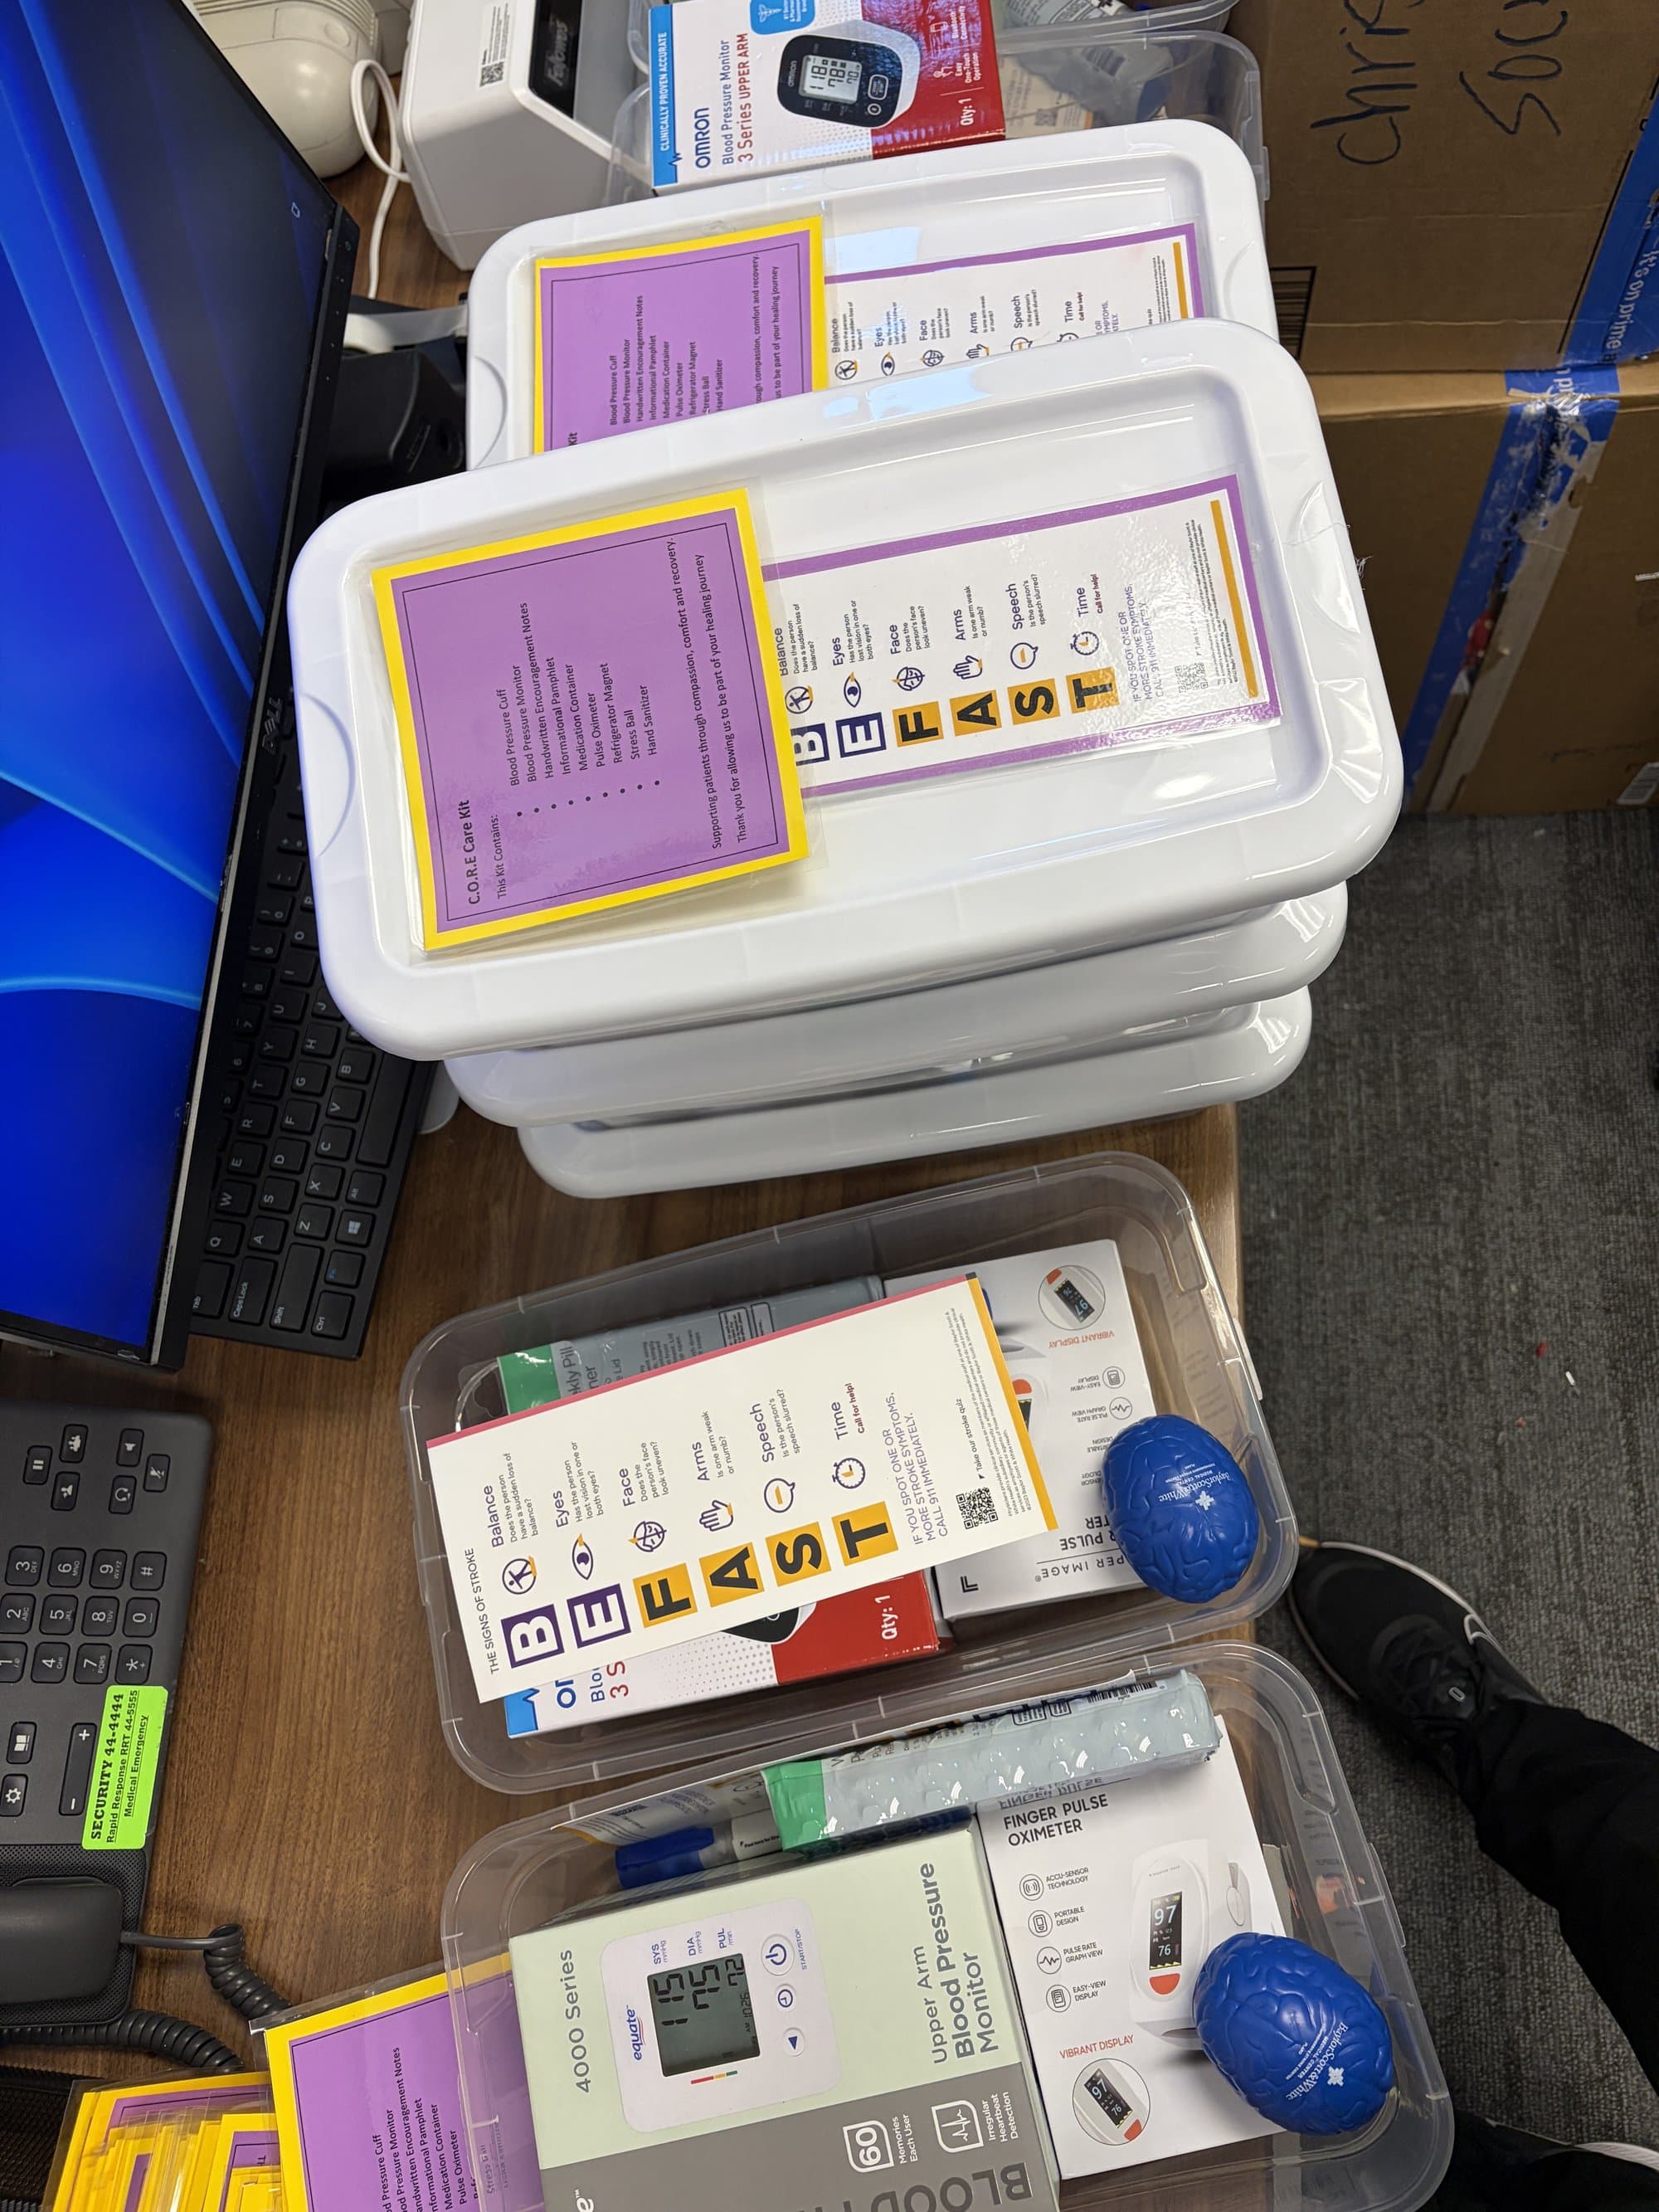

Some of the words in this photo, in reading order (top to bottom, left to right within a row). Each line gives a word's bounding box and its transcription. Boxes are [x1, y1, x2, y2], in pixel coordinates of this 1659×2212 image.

[658, 32, 668, 72] ACCURATE
[718, 40, 731, 81] Monitor
[736, 32, 749, 58] ARM
[659, 73, 669, 105] PROVEN
[737, 61, 751, 100] UPPER
[721, 84, 732, 131] Pressure
[736, 102, 753, 149] Series
[960, 105, 976, 126] Qty:
[659, 105, 669, 152] CLINICALLY
[721, 133, 734, 165] Blood
[737, 153, 754, 163] 3
[635, 295, 644, 318] Notes
[635, 318, 645, 376] Encouragement
[635, 376, 645, 422] Handwritten
[666, 538, 681, 585] recovery.
[694, 554, 711, 593] journey
[672, 587, 685, 607] and
[702, 594, 715, 632] healing
[1005, 583, 1025, 631] Speech
[1076, 587, 1089, 618] Time
[520, 602, 532, 634] Notes
[677, 608, 692, 649] comfort
[953, 609, 966, 641] Arms
[708, 633, 722, 656] your
[832, 637, 845, 666] Eyes
[889, 624, 902, 655] Face
[523, 635, 545, 714] Encouragement
[545, 656, 562, 705] Pamphlet
[686, 650, 703, 712] compassion,
[709, 658, 722, 669] of
[713, 670, 727, 691] part
[495, 689, 509, 710] Cuff
[512, 665, 526, 706] Monitor
[565, 664, 580, 713] Container
[599, 662, 614, 702] Magnet
[717, 693, 727, 707] be
[1072, 678, 1113, 709] T
[587, 692, 601, 738] Oximeter
[623, 709, 635, 728] Ball
[639, 685, 654, 728] Sanitizer
[721, 708, 729, 719] to
[956, 692, 997, 726] A
[1014, 686, 1054, 717] S
[503, 711, 516, 755] Pressure
[519, 708, 533, 752] Pressure
[552, 706, 572, 775] Informational
[572, 714, 589, 772] Medication
[606, 704, 623, 764] Refrigerator
[628, 729, 641, 760] Stress
[644, 728, 658, 756] Hand
[693, 713, 709, 753] through
[722, 720, 732, 733] us
[841, 719, 881, 752] E
[898, 711, 939, 743] F
[538, 715, 554, 779] Handwritten
[594, 740, 606, 767] Pulse
[724, 733, 738, 775] allowing
[506, 757, 520, 787] Blood
[523, 753, 538, 782] Blood
[701, 753, 718, 794] patients
[730, 777, 741, 792] for
[458, 799, 471, 820] Kit
[733, 793, 746, 812] you
[463, 822, 475, 853] Care
[490, 814, 504, 861] Contains:
[708, 795, 723, 850] Supporting
[734, 812, 747, 844] Thank
[465, 855, 480, 904] C.O.R.E
[494, 863, 505, 877] Kit
[497, 878, 507, 899] This
[844, 1382, 857, 1404] help!
[852, 1404, 860, 1417] for
[955, 1398, 966, 1414] quiz
[749, 1403, 776, 1463] Speech
[831, 1401, 849, 1440] Time
[854, 1417, 865, 1434] Call
[882, 1428, 894, 1446] OR
[885, 1392, 912, 1458] SYMPTOMS,
[961, 1415, 973, 1439] stroke
[503, 1453, 512, 1461] of
[692, 1441, 710, 1481] Arms
[887, 1447, 902, 1473] ONE
[903, 1412, 934, 1487] IMMEDIATELY.
[968, 1440, 977, 1453] our
[974, 1454, 983, 1472] Take
[507, 1462, 515, 1479] loss
[619, 1468, 636, 1507] Face
[903, 1459, 925, 1505] STROKE
[499, 1474, 512, 1504] person
[510, 1479, 522, 1511] sudden
[895, 1476, 912, 1506] SPOT
[926, 1488, 939, 1505] 911
[484, 1485, 504, 1547] Balance
[504, 1505, 513, 1520] the
[523, 1498, 538, 1537] balance?
[552, 1490, 570, 1527] Eyes
[904, 1508, 919, 1533] YOU
[917, 1506, 937, 1542] MORE
[932, 1505, 948, 1537] CALL
[508, 1520, 518, 1543] Does
[518, 1518, 528, 1540] have
[839, 1518, 889, 1559] T
[912, 1534, 924, 1545] IF
[464, 1547, 482, 1594] STROKE
[709, 1547, 758, 1590] A
[776, 1533, 822, 1575] S
[474, 1596, 486, 1612] OF
[573, 1593, 625, 1642] E
[640, 1578, 692, 1621] F
[874, 1595, 891, 1604] 1
[479, 1613, 494, 1649] SIGNS
[510, 1615, 558, 1662] B
[881, 1607, 898, 1640] Qty:
[486, 1651, 499, 1675] THE
[124, 1689, 137, 1731] 44-5555
[120, 1733, 130, 1755] RRT
[130, 1715, 148, 1772] Emergency
[90, 1759, 113, 1839] SECURITY
[104, 1694, 124, 1756] 44-4444
[111, 1758, 126, 1809] Response
[124, 1776, 137, 1816] Medical
[1003, 1805, 1058, 1830] FINGER
[1062, 1793, 1108, 1816] PULSE
[106, 1812, 118, 1842] Rapid
[1008, 1818, 1083, 1846] OXIMETER
[920, 1863, 956, 1972] Pressure
[651, 1943, 662, 1965] SYS
[686, 1937, 697, 1956] DIA
[717, 1927, 727, 1949] PUL
[795, 1928, 807, 1971] START/STOP
[560, 1950, 581, 2020] Series
[725, 1955, 748, 1988] 72
[913, 1946, 933, 1990] Arm
[653, 1974, 688, 2029] 115
[688, 1964, 721, 2010] 75
[962, 1952, 999, 2054] Monitor
[923, 1998, 948, 2064] Upper
[940, 1978, 975, 2059] Blood
[568, 2028, 591, 2093] 4000
[1058, 2042, 1097, 2059] VIBRANT
[1098, 2034, 1134, 2051] DISPLAY
[902, 2114, 912, 2136] User
[981, 2099, 996, 2141] Irregular
[990, 2093, 1008, 2141] Heartbeat
[1002, 2092, 1019, 2138] Detection
[855, 2126, 882, 2166] 60
[892, 2117, 907, 2165] Memories
[907, 2137, 918, 2162] Each
